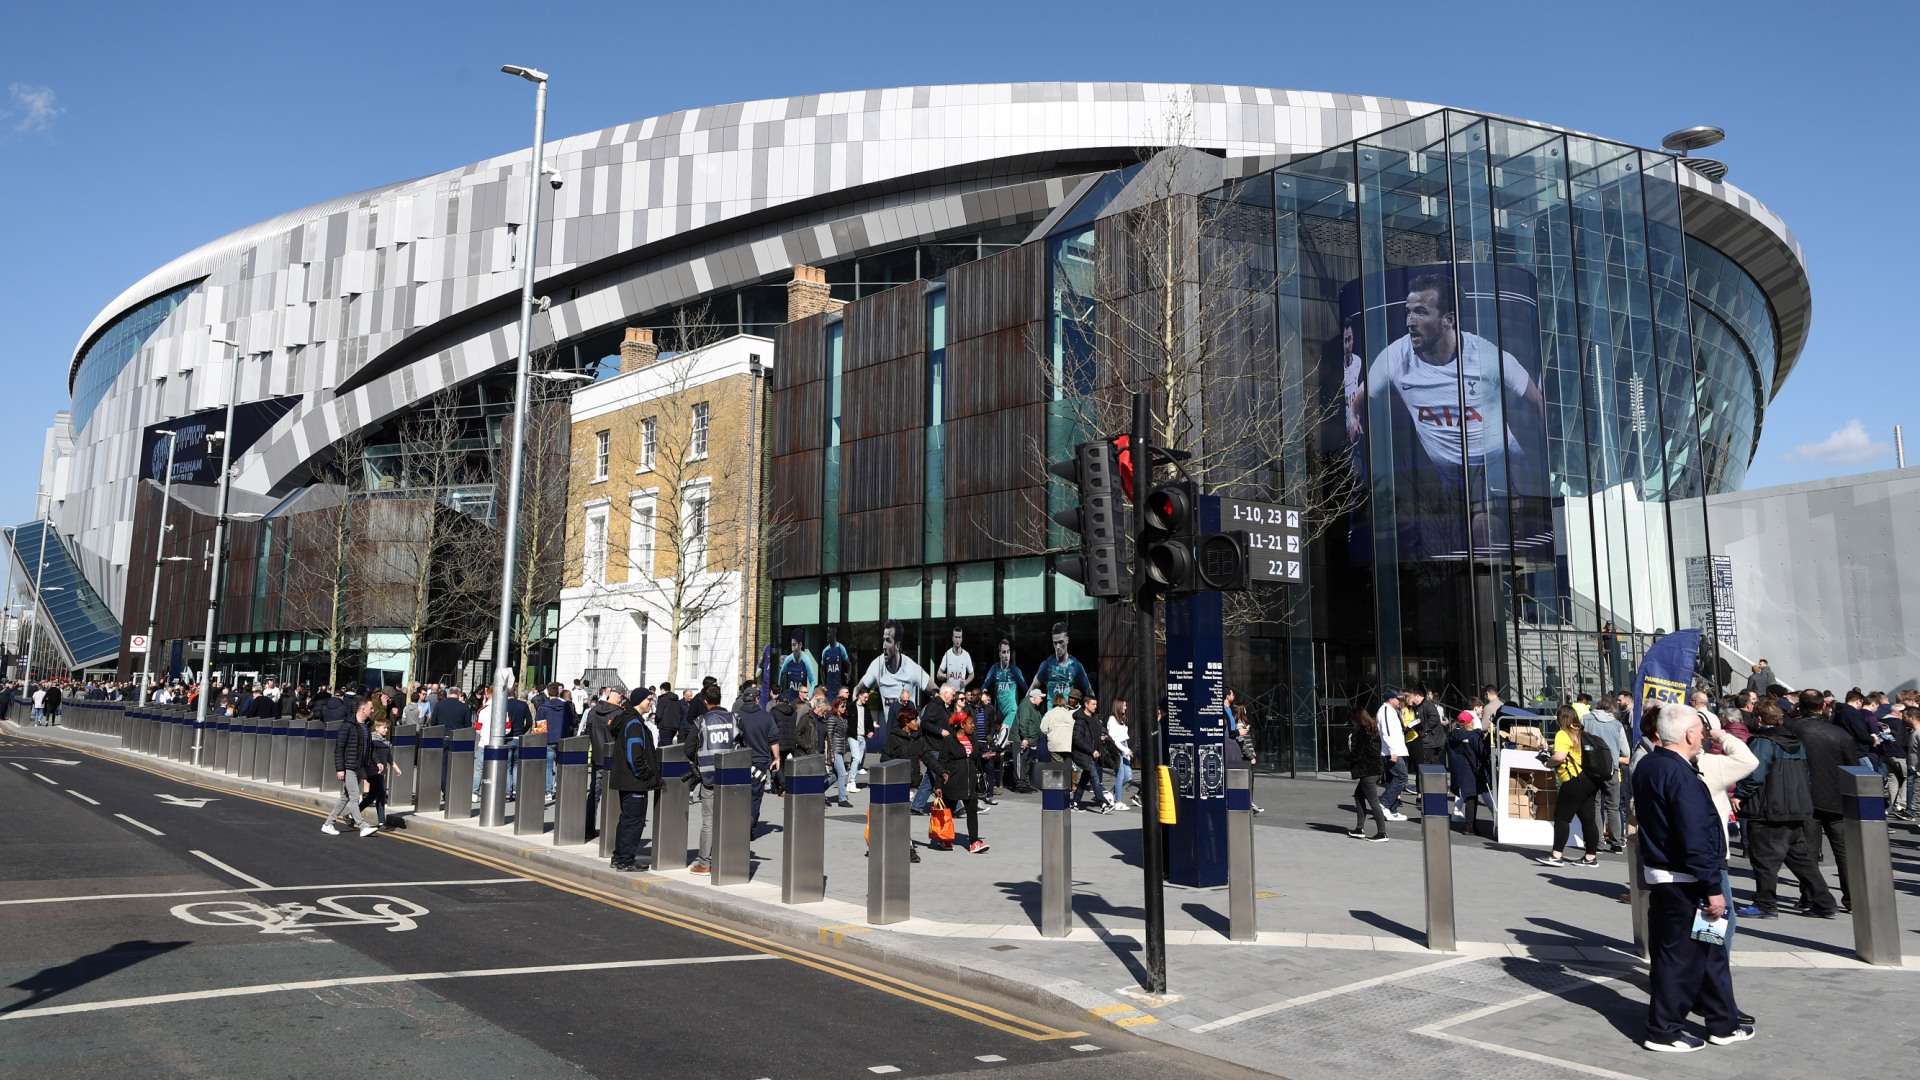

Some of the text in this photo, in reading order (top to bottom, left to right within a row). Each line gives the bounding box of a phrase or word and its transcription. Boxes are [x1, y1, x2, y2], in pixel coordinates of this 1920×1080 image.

[1418, 406, 1484, 427] AIA
[1233, 504, 1282, 525] 1-10, 23
[1249, 532, 1282, 550] 11-21
[1268, 560, 1283, 576] 22
[827, 663, 840, 673] AIA
[948, 671, 963, 680] AIA
[998, 682, 1010, 691] AIA
[1053, 683, 1071, 694] AIA
[1645, 686, 1683, 705] ASK
[710, 731, 729, 744] 004
